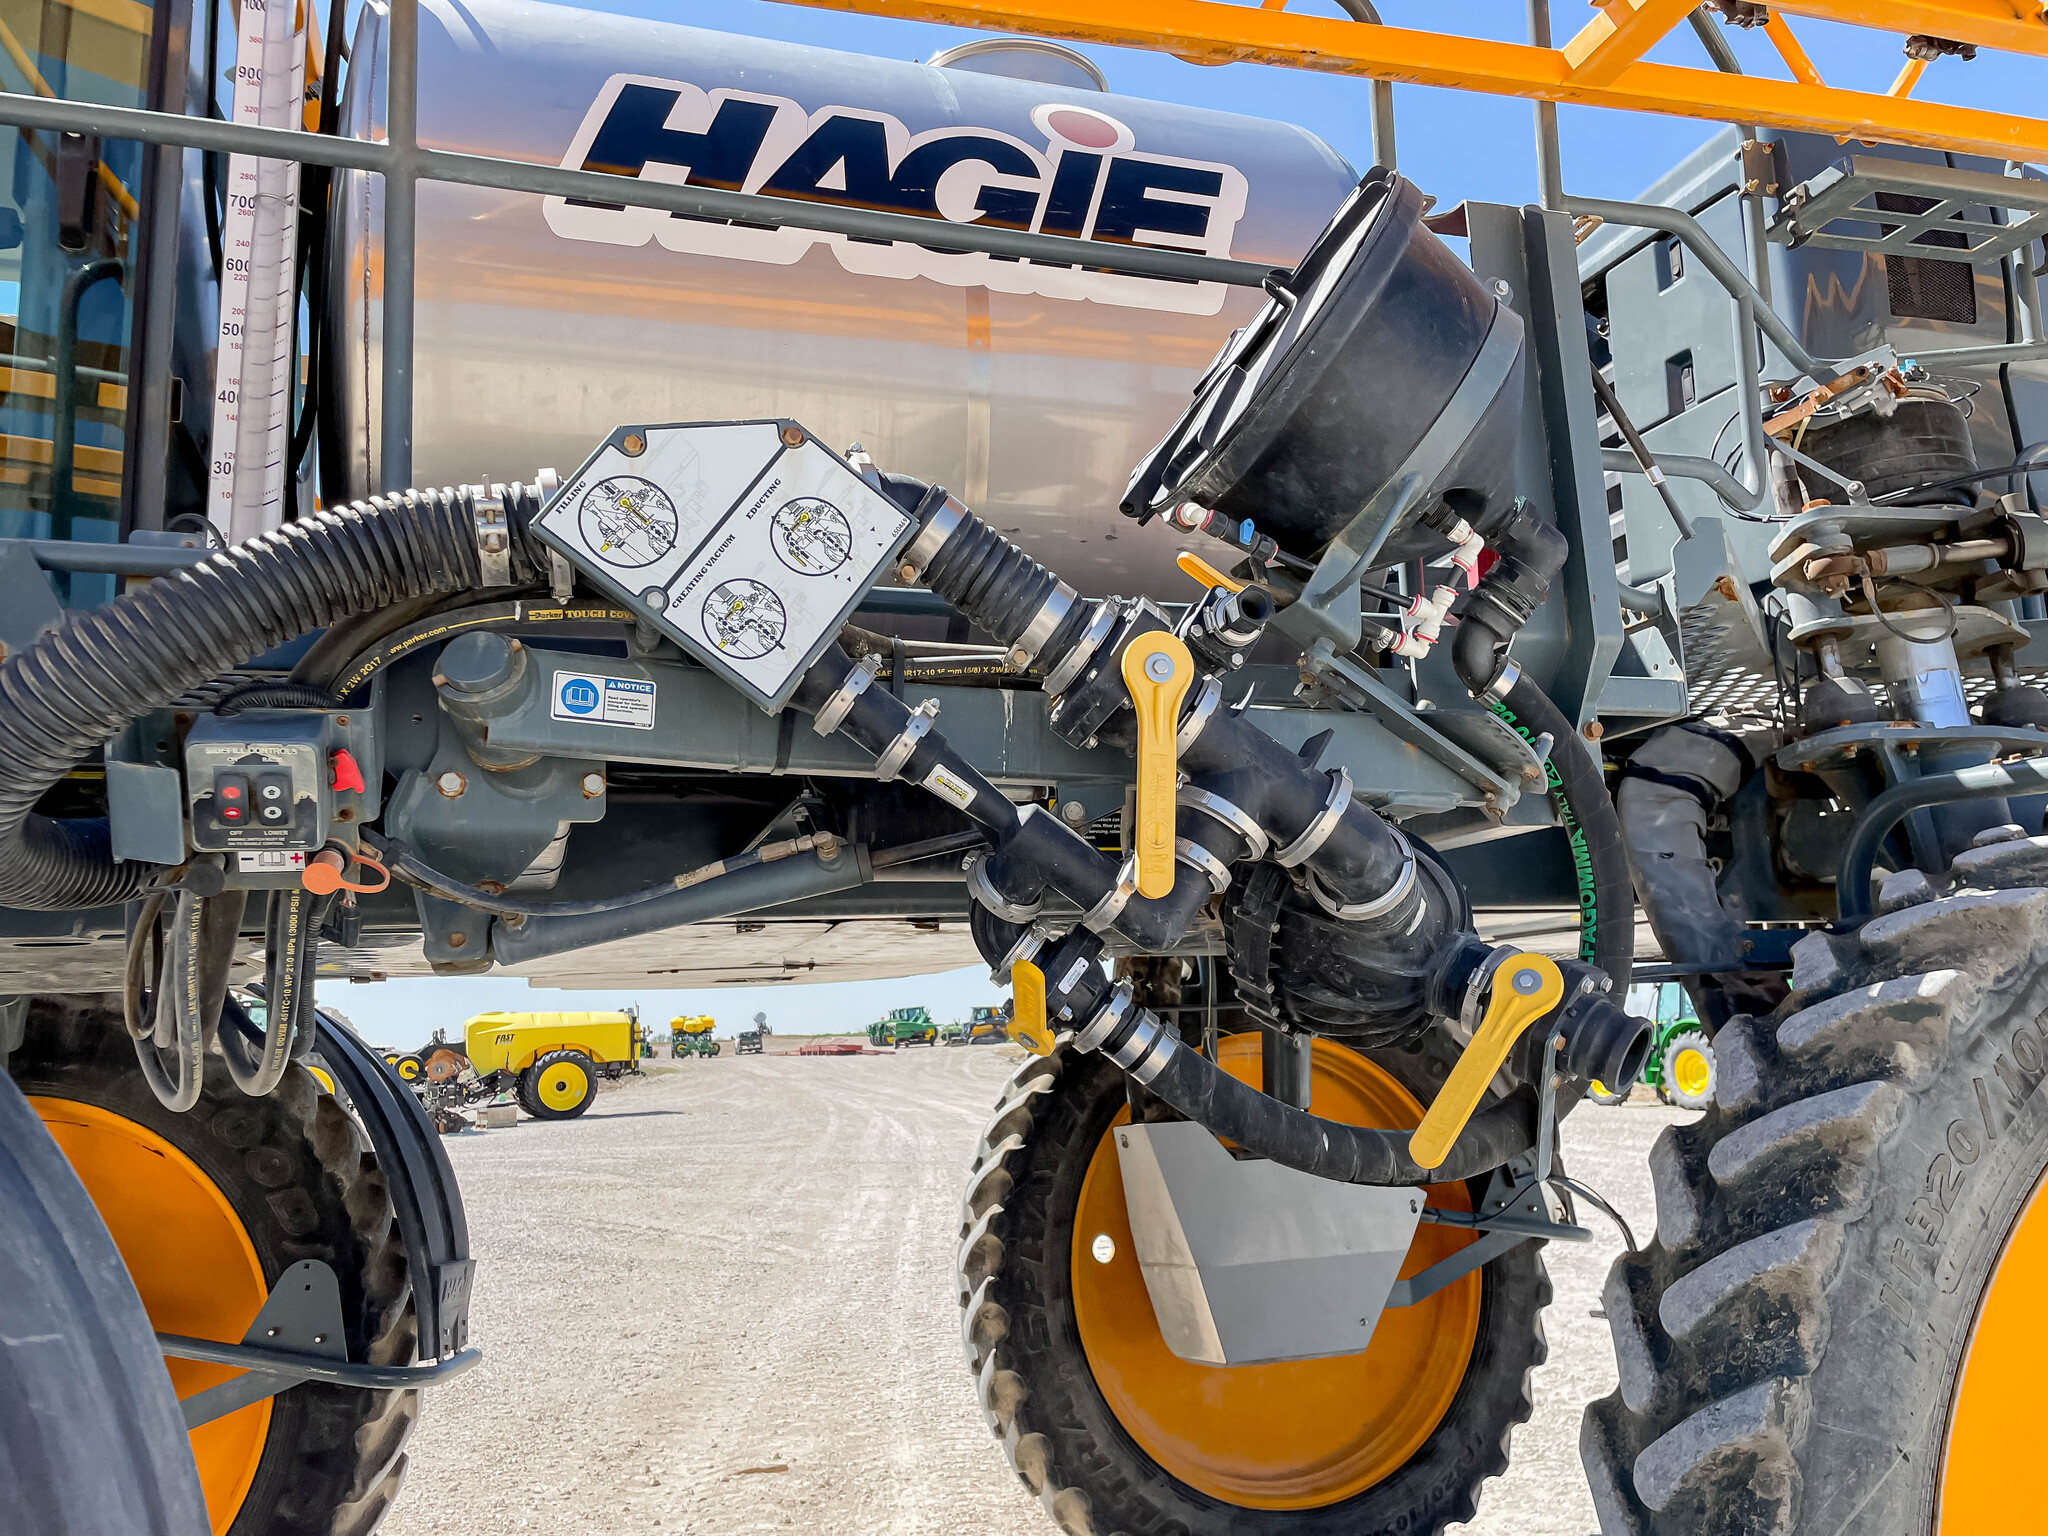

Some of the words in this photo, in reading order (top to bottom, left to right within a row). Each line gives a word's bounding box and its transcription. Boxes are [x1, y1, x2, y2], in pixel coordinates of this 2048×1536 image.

[563, 82, 1225, 286] HAGIE
[229, 194, 256, 209] 700
[554, 480, 588, 516] FILLING
[745, 477, 782, 520] EDUCTING
[671, 566, 708, 609] CREATING
[705, 534, 736, 567] VACUUM
[566, 610, 606, 619] TOUGH
[360, 656, 382, 676] 2Q17
[875, 670, 893, 678] SAE
[618, 682, 651, 692] NOTICE
[248, 747, 298, 755] CONTROLS
[1554, 791, 1577, 826] ITALY
[287, 938, 297, 957] MPa
[284, 973, 293, 988] WP
[280, 988, 292, 1022] 451TC-10
[495, 1033, 516, 1045] FAST
